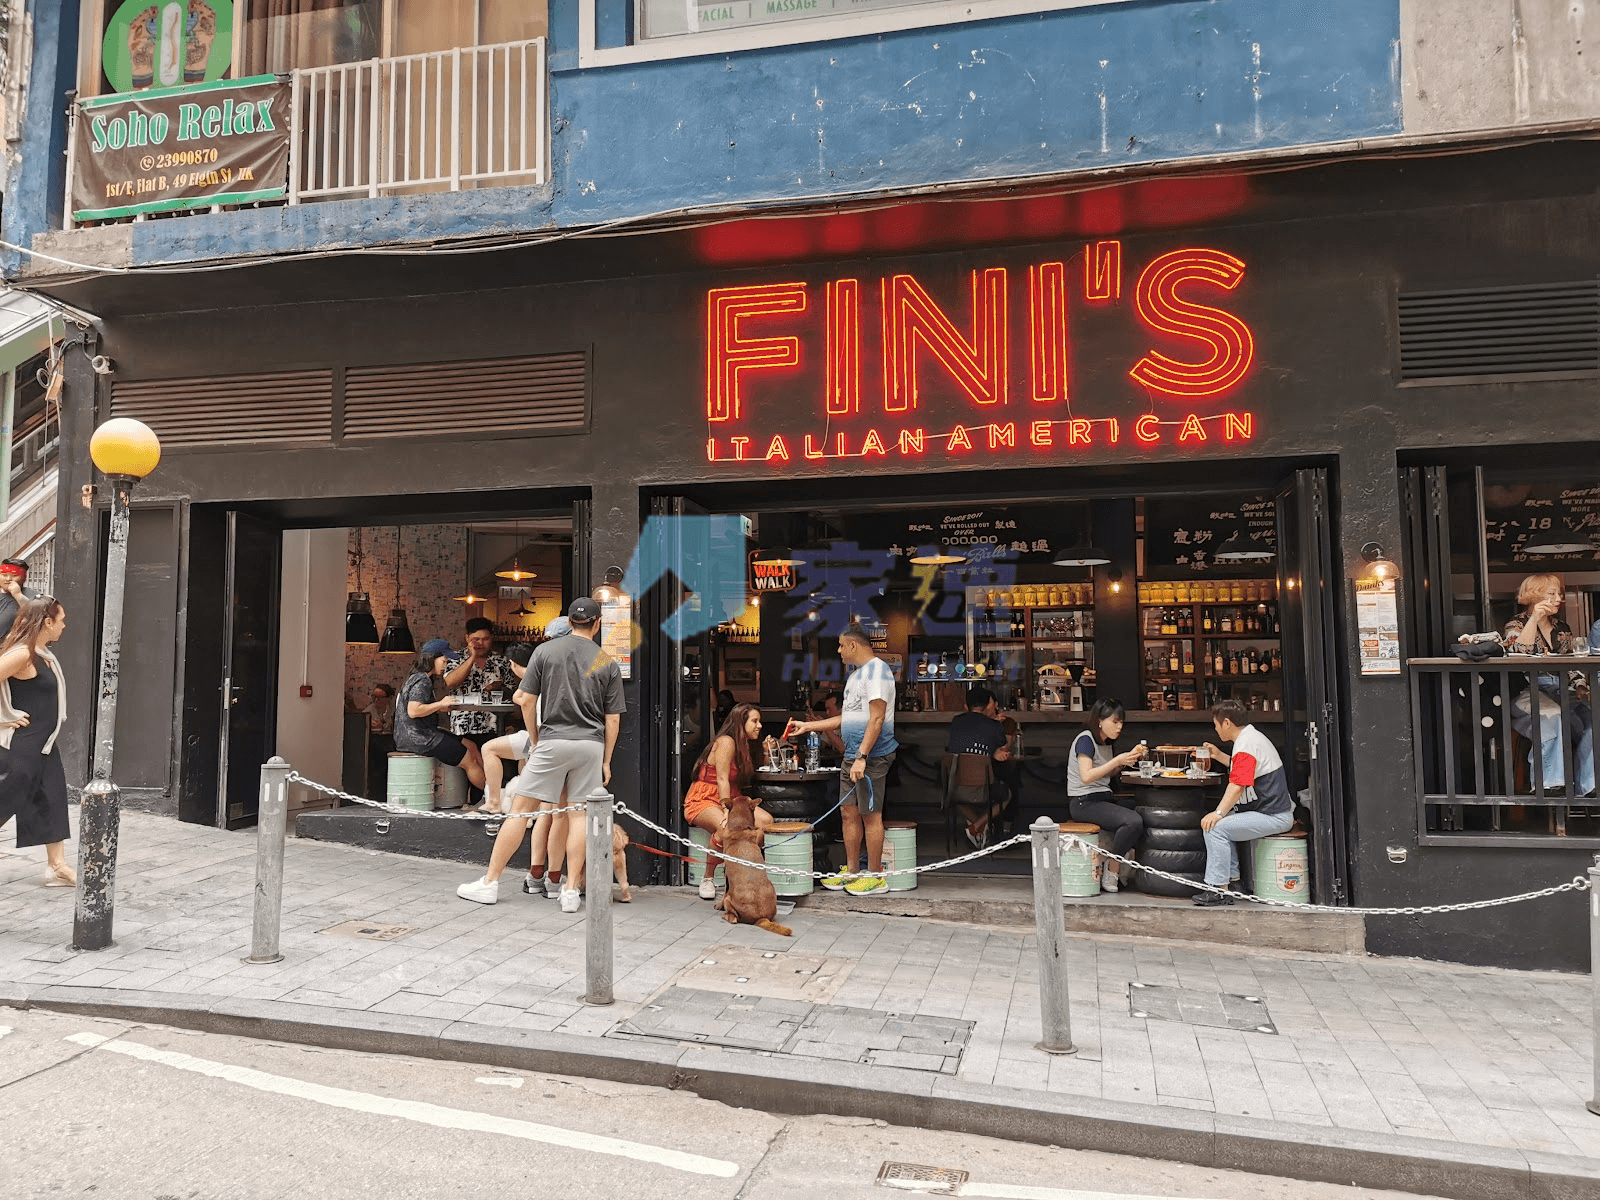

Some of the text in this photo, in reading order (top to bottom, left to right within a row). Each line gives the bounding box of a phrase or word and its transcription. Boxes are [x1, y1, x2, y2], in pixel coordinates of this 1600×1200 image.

[698, 0, 818, 22] FACIAL MASSAGE
[91, 97, 276, 153] Soho Relax
[156, 147, 218, 169] 23990870
[136, 177, 157, 194] Flat
[159, 176, 170, 191] B,
[172, 174, 187, 189] 49
[188, 168, 220, 188] Elgin
[237, 166, 255, 182] HK
[706, 240, 1255, 421] FINI'S
[1528, 517, 1552, 530] 18
[753, 563, 790, 578] WALK
[755, 575, 791, 590] WALK
